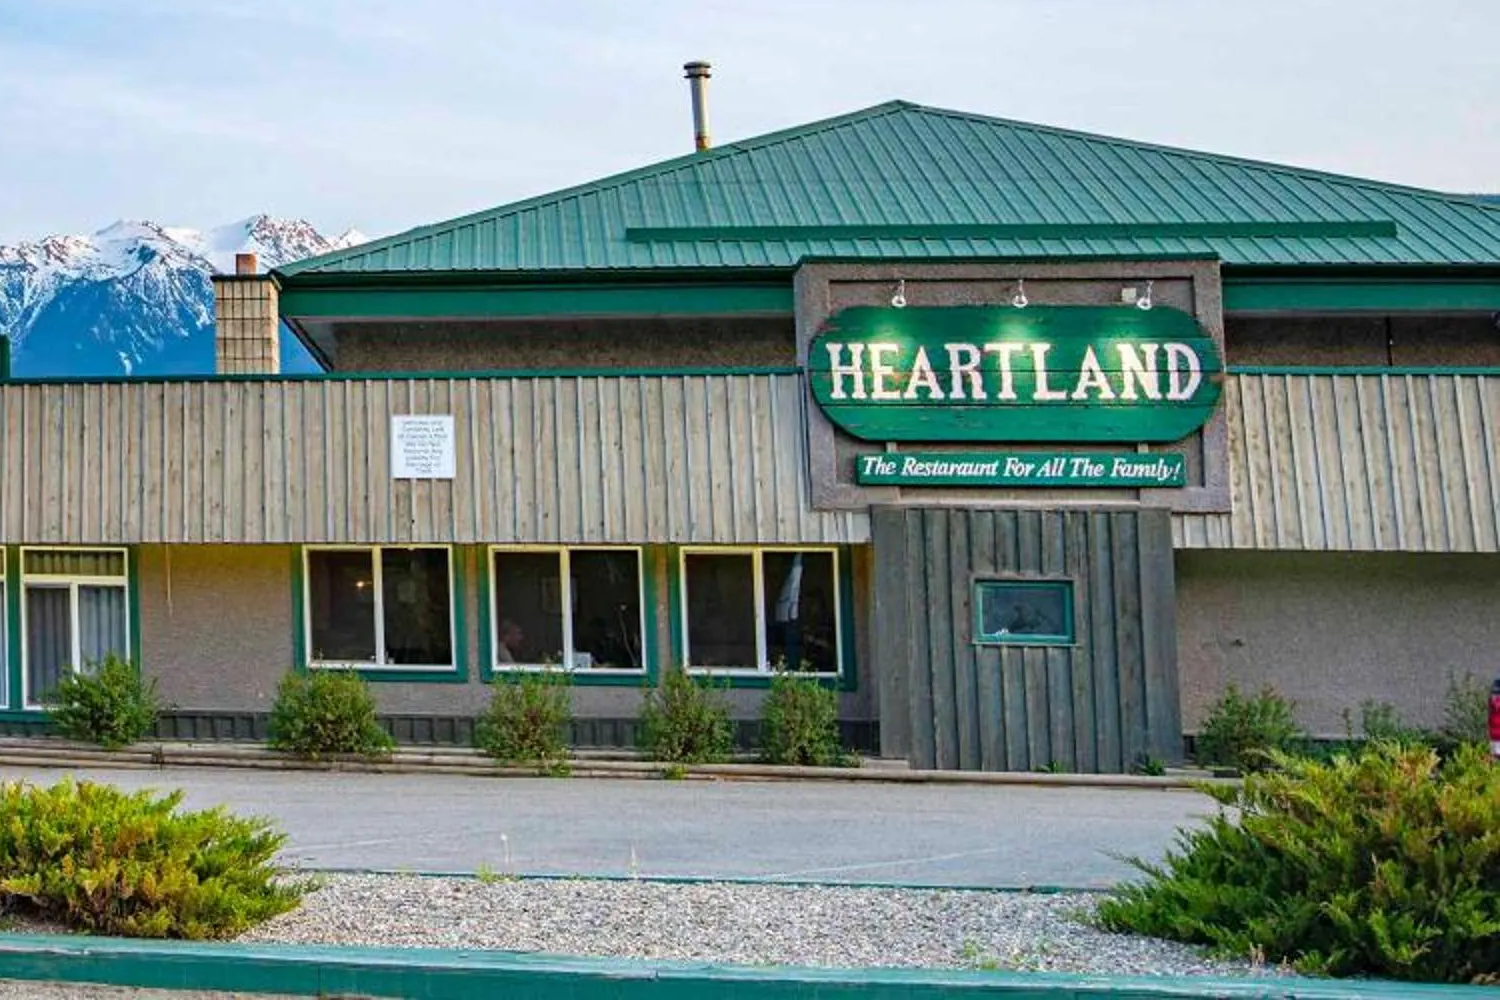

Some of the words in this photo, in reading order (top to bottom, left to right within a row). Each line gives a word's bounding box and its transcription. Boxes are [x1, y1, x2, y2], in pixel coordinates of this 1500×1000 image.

[825, 342, 1202, 401] HEARTLAND
[863, 456, 897, 476] The
[1003, 456, 1035, 478] For
[1036, 456, 1065, 478] All
[1069, 457, 1105, 478] The
[1110, 457, 1181, 482] Family!
